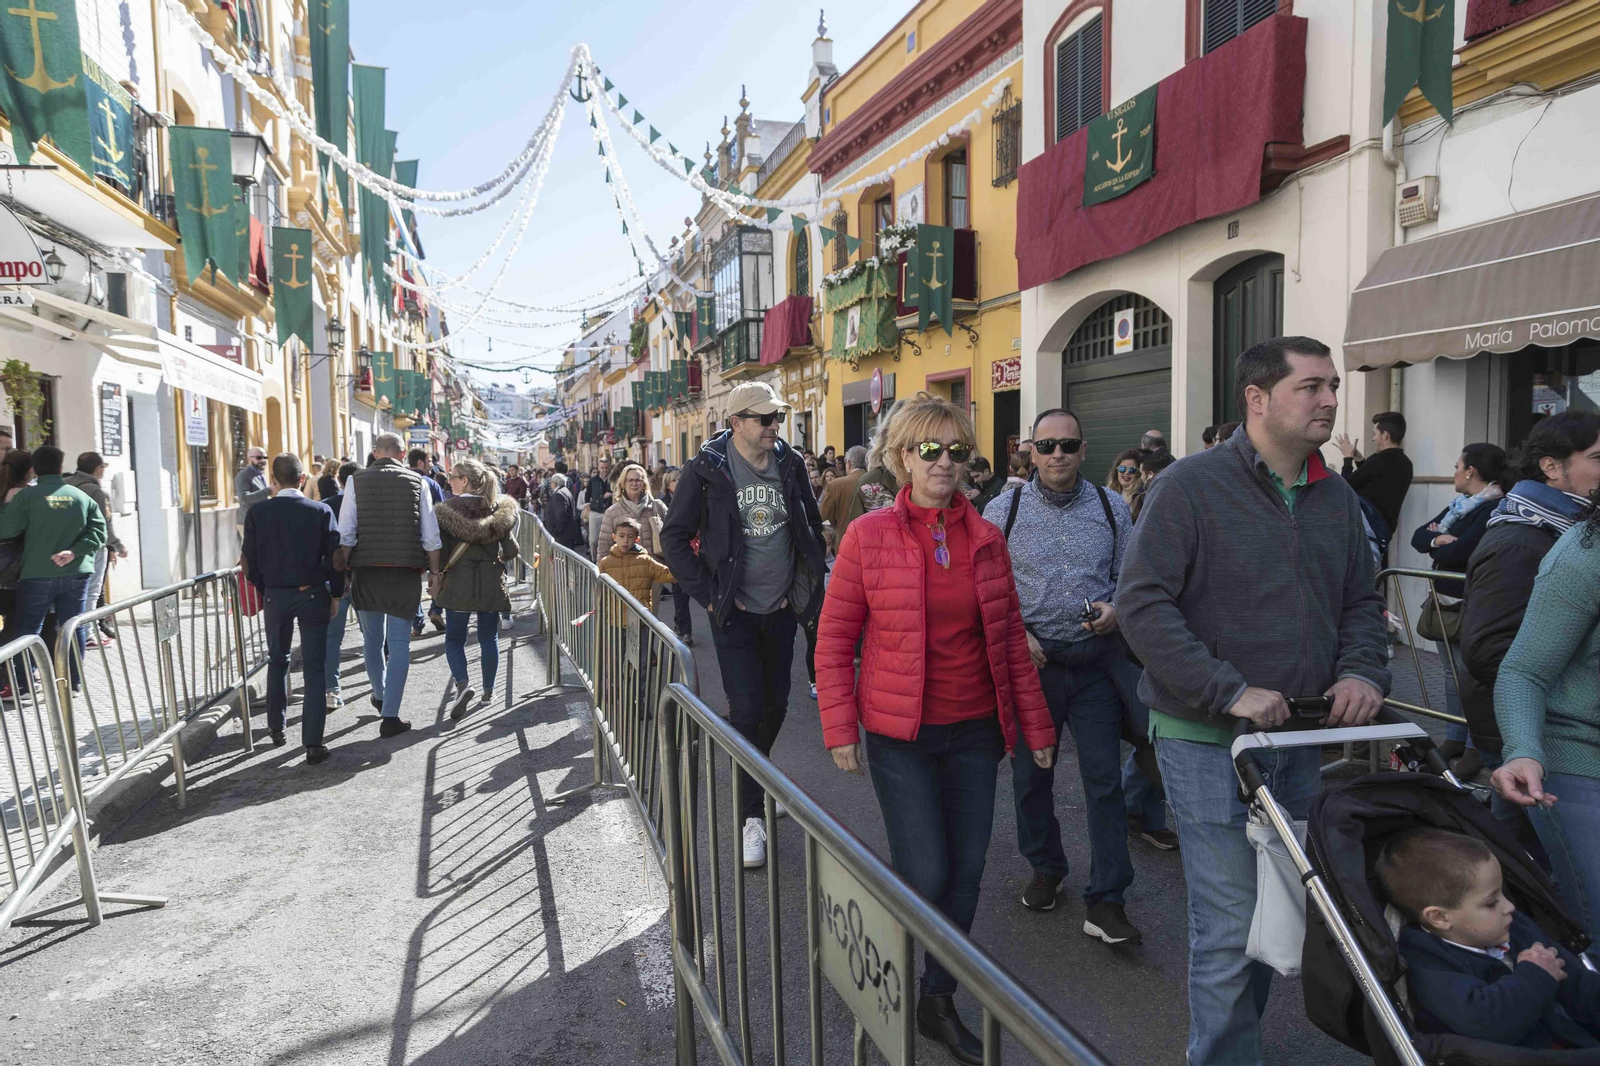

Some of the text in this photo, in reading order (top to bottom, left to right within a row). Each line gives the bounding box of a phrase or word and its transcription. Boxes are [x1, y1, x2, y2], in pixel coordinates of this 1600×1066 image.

[1114, 98, 1137, 118] SIGLOS
[0, 296, 24, 304] RA
[1465, 327, 1513, 350] María
